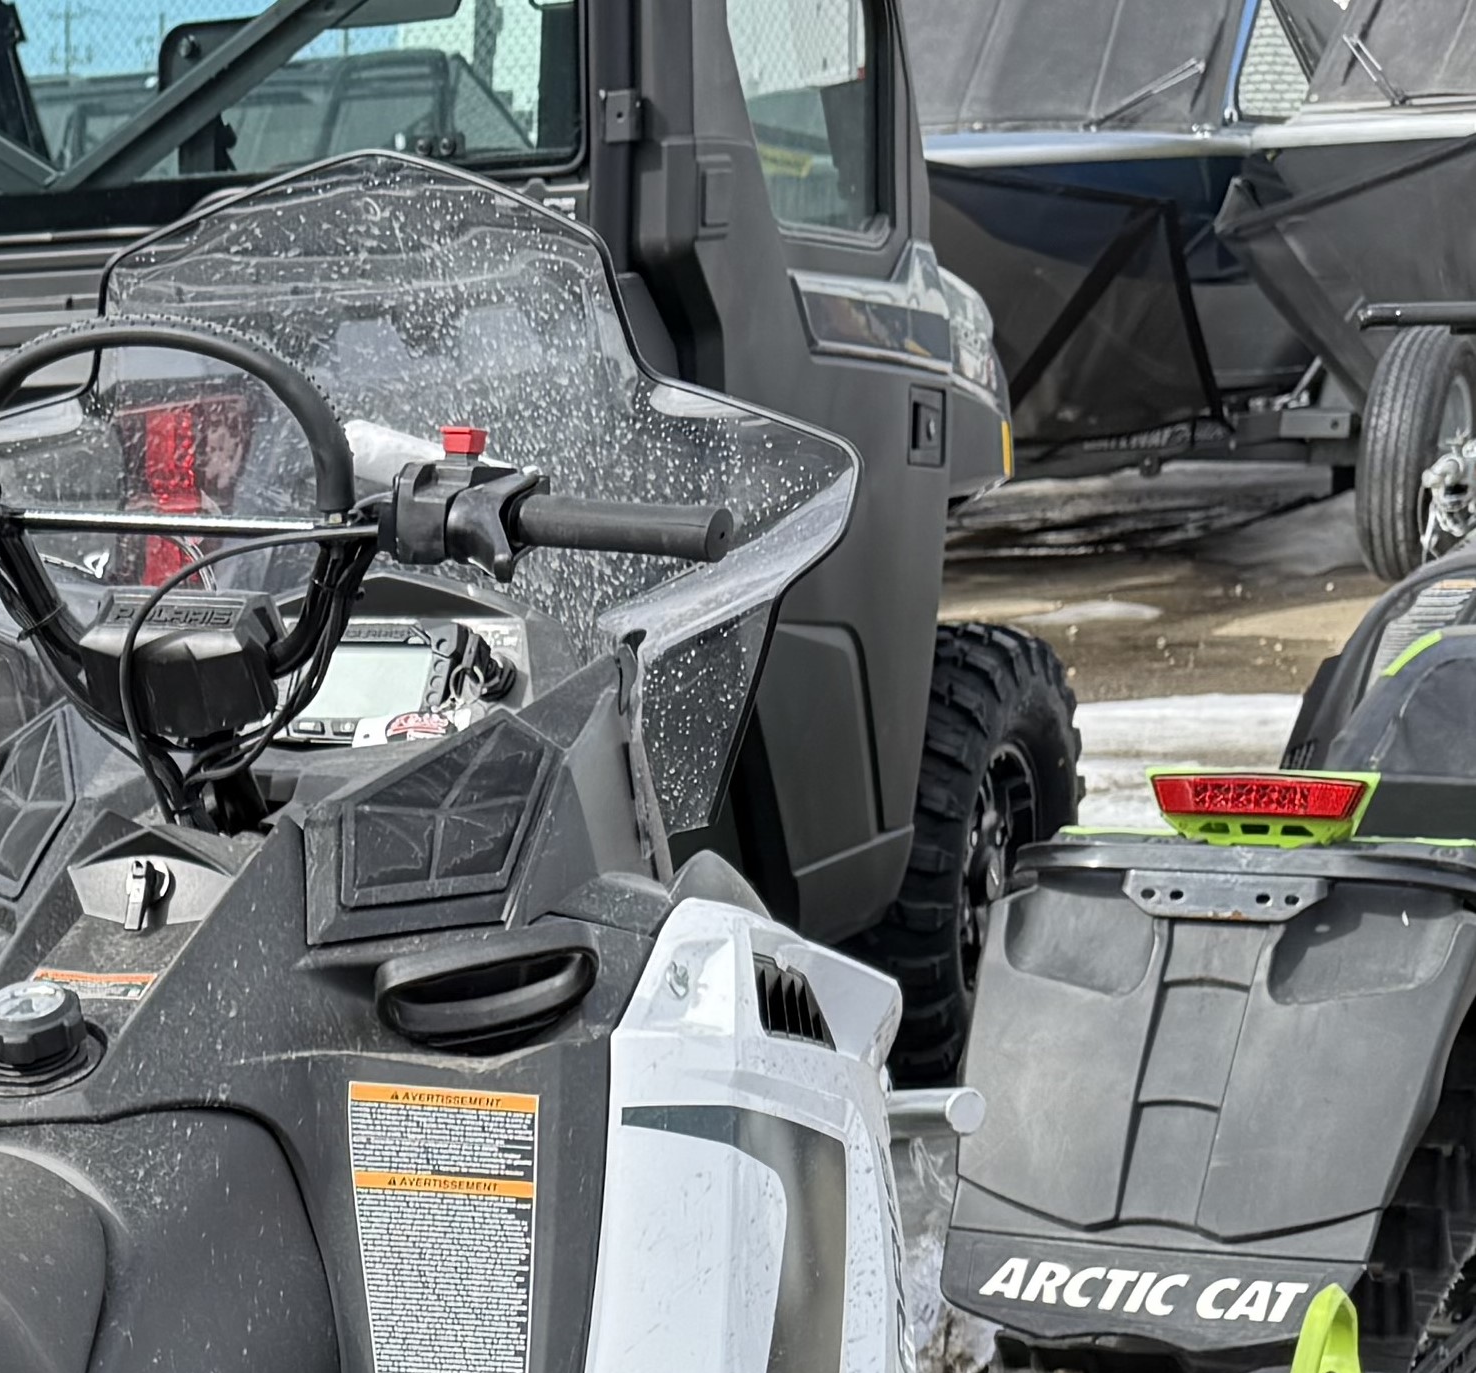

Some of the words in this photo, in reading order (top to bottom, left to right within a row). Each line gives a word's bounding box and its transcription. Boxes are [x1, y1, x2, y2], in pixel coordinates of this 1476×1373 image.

[114, 606, 233, 626] PLARIS
[402, 1091, 502, 1108] AVERTISSEMENT
[400, 1176, 499, 1192] AVERTISSEMENT
[979, 1257, 1190, 1317] ARCTIC
[1196, 1278, 1309, 1323] CAT
